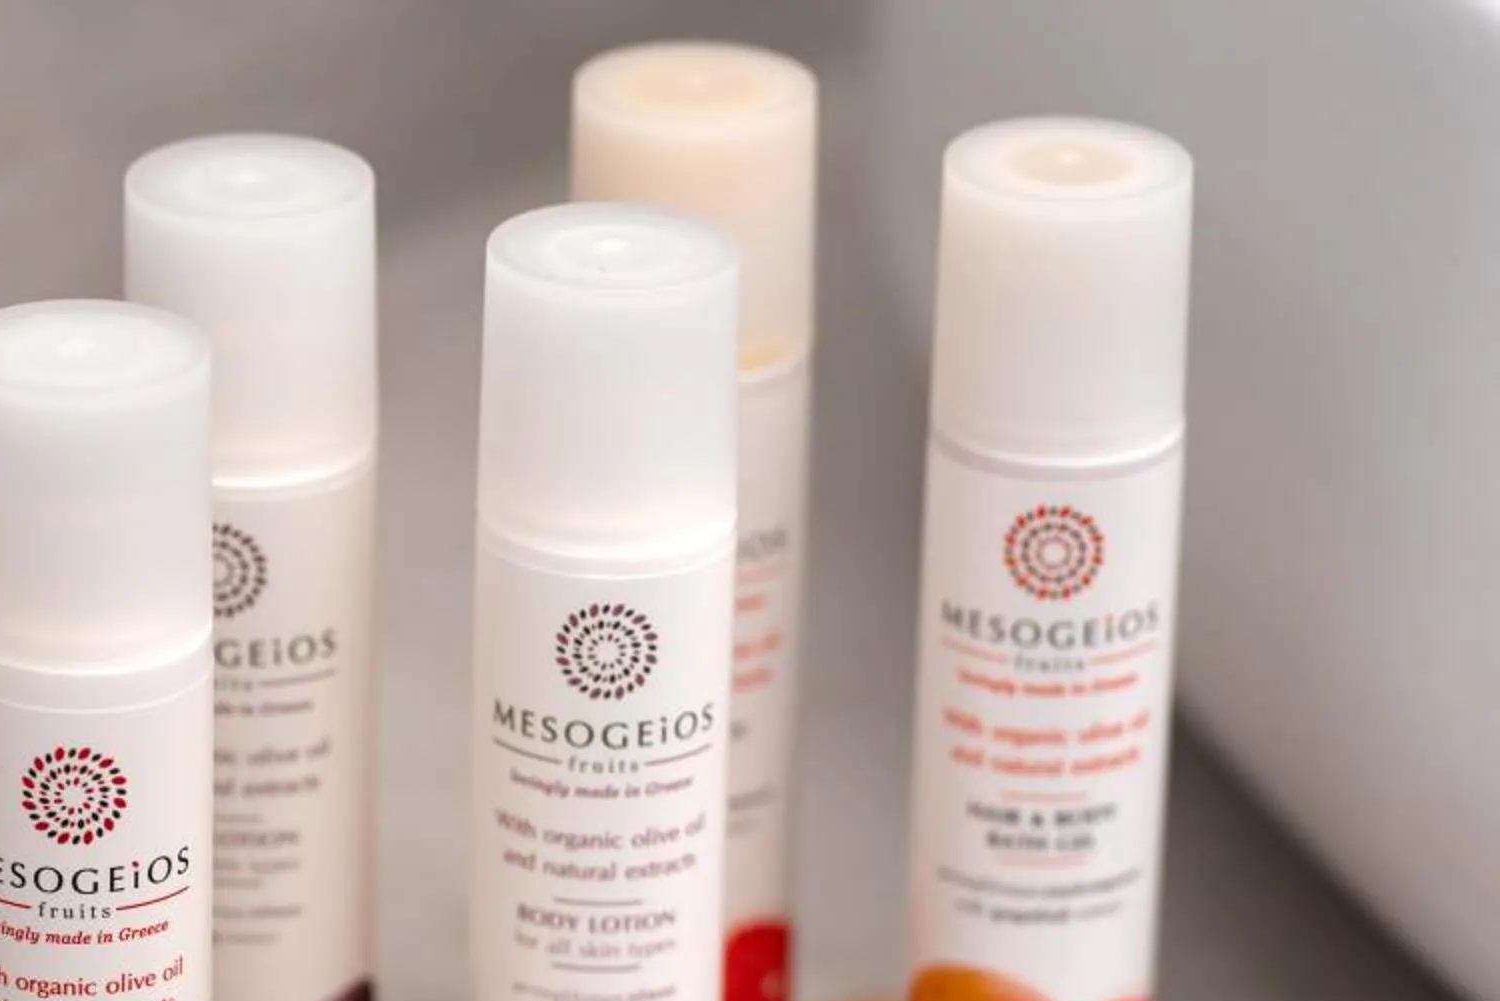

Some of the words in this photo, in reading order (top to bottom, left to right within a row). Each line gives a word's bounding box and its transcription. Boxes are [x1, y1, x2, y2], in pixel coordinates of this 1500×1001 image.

[493, 698, 715, 750] MESOGEiOS
[567, 756, 639, 773] fruits
[542, 825, 623, 851] organic
[630, 826, 680, 848] olive
[542, 860, 617, 881] natural
[38, 902, 111, 920] fruits
[45, 928, 91, 944] made
[97, 928, 113, 944] in
[119, 921, 169, 942] Greece
[15, 976, 97, 999] organic
[105, 972, 156, 996] olive
[163, 954, 184, 982] oil
